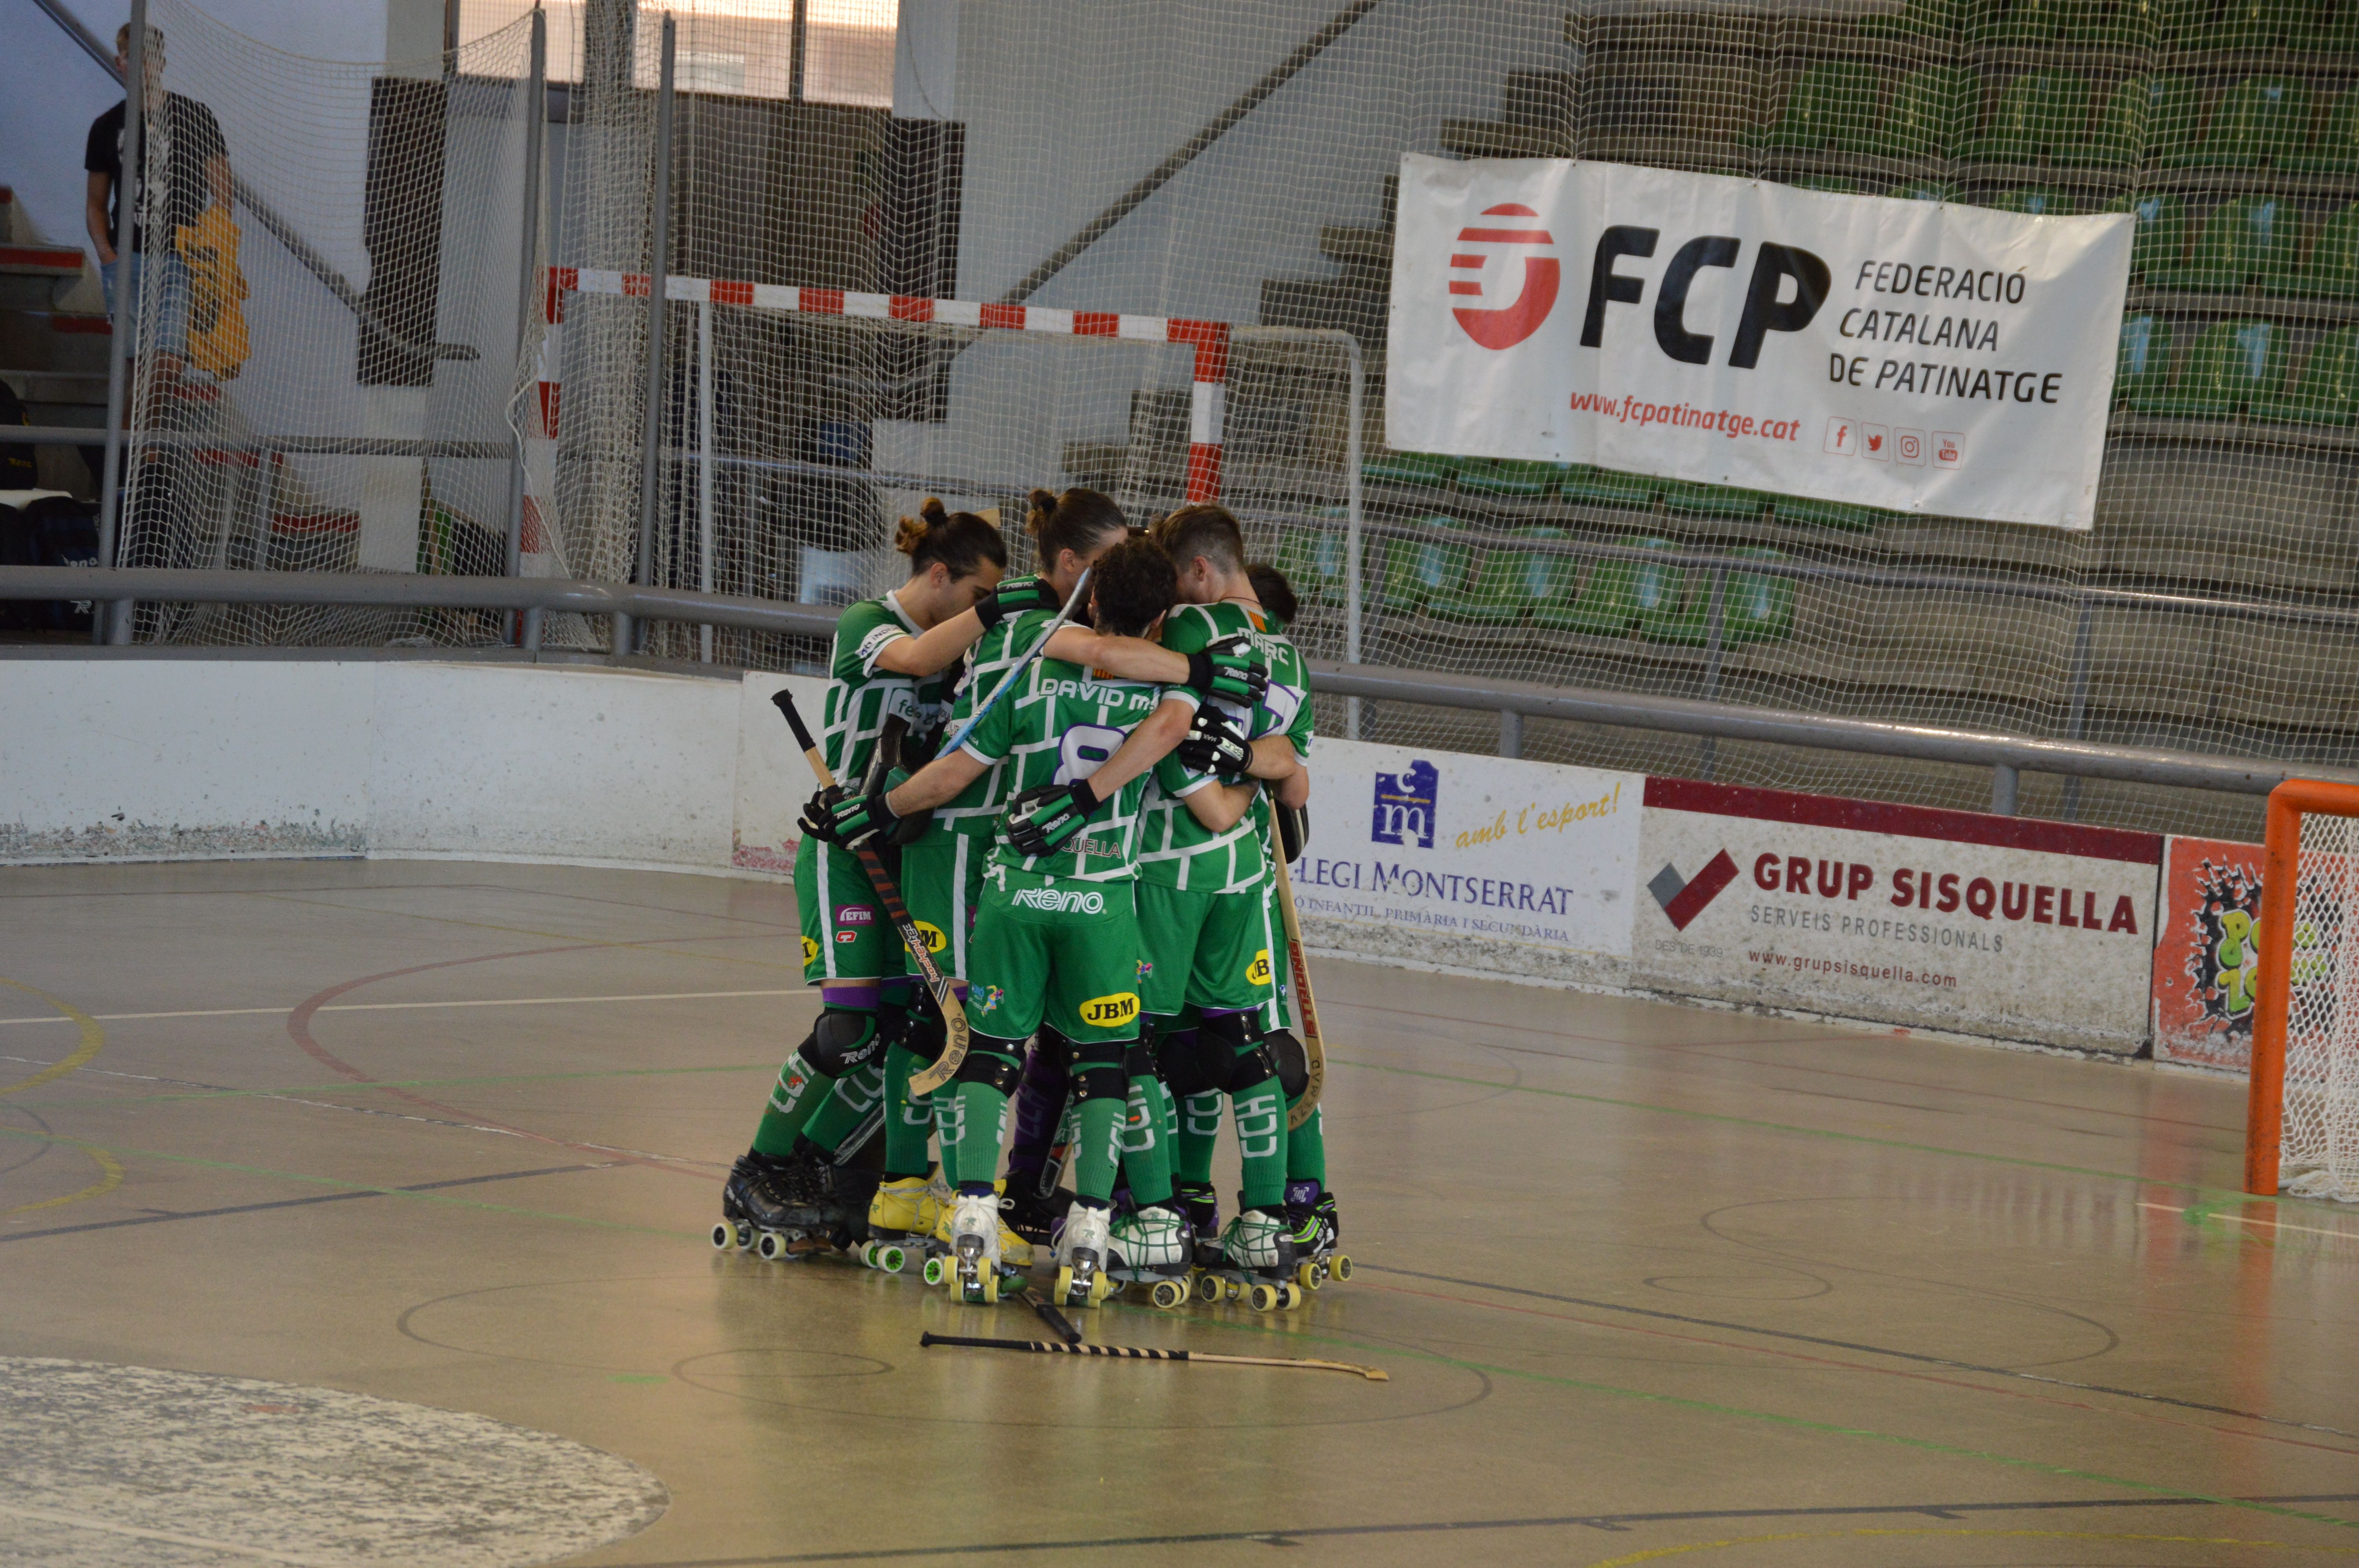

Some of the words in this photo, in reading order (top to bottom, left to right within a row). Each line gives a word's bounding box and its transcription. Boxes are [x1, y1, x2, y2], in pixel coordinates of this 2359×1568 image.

[1580, 224, 1831, 369] FCP
[1855, 260, 2027, 304] FEDERACIÓ
[1839, 307, 1999, 351] CATALANA
[1830, 352, 1869, 386] DE
[1875, 359, 2063, 403] PATINATGE
[1570, 392, 1801, 441] www.fcpatinatge.cat
[1237, 627, 1289, 666] MARC
[1040, 678, 1124, 707] DAVID
[1041, 813, 1071, 833] Reno
[1455, 809, 1508, 848] amb
[1517, 782, 1621, 834] l'esport!
[1061, 838, 1121, 859] QUELLA
[1011, 888, 1103, 915] Reno
[1372, 861, 1574, 915] MONTSERRAT
[1754, 852, 1874, 901] GRUP
[1890, 867, 2139, 935] SISQUELLA
[845, 911, 871, 921] EFIM
[1385, 907, 1458, 927] PRIMÀRIA
[1751, 904, 1831, 931] SERVEIS
[1842, 915, 2003, 953] PROFESSIONALS
[1654, 939, 1676, 952] DES
[1680, 942, 1695, 954] DE
[1699, 945, 1723, 958] 1939
[1251, 958, 1269, 980] JB
[1748, 949, 1957, 988] www.grupsisquella.com
[1288, 940, 1318, 1038] STRONG
[1087, 998, 1134, 1020] JBM
[840, 1033, 881, 1064] Reno
[929, 1018, 969, 1082] Reno
